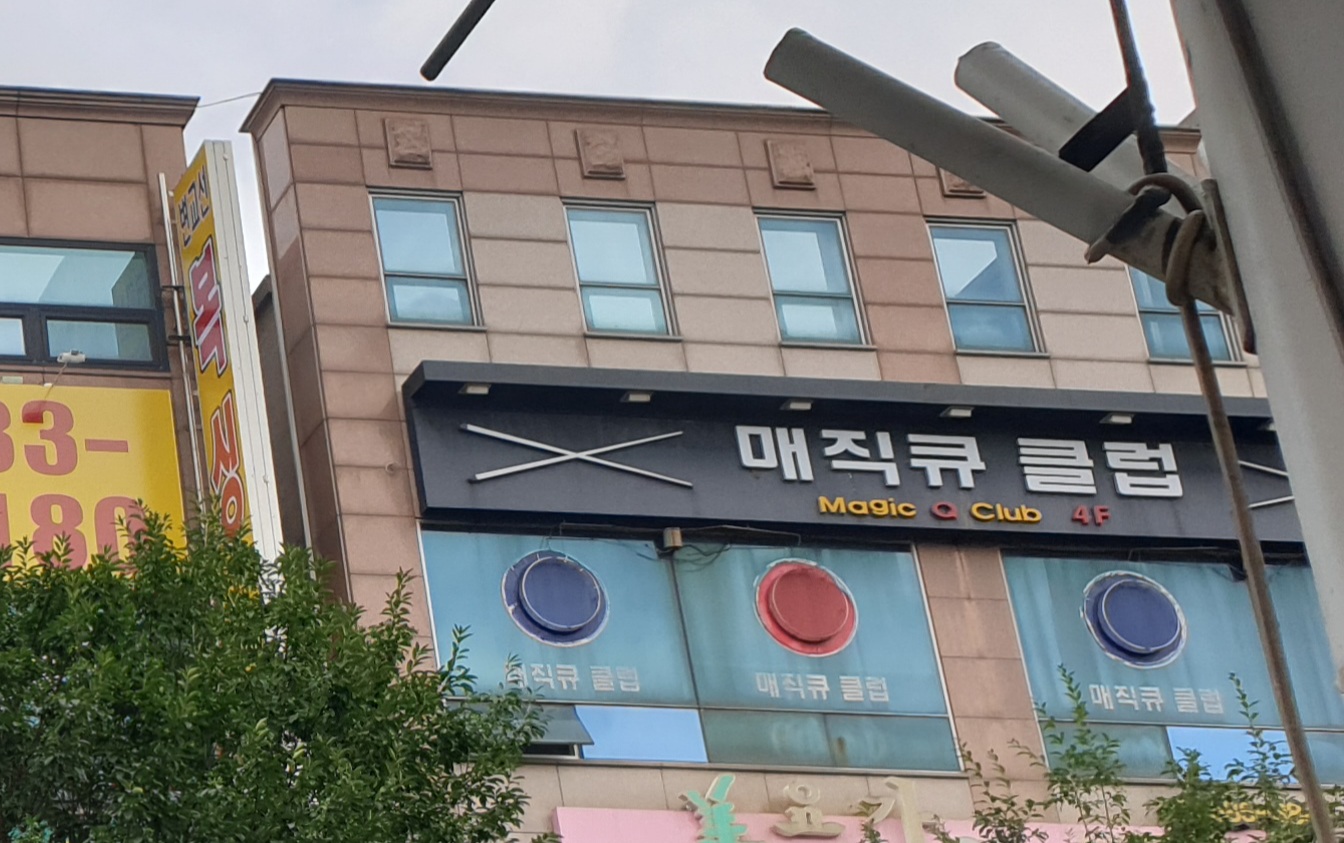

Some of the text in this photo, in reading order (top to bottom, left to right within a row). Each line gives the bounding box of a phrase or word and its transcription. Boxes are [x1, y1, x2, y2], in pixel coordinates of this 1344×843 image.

[178, 165, 210, 247] 변교선
[188, 235, 245, 540] 복싱
[734, 424, 1184, 498] 매직큐 클럽
[817, 495, 1110, 526] Magic Q Club 4F
[589, 665, 641, 693] 클럽
[755, 671, 891, 702] 매직큐 클럽
[1088, 683, 1225, 715] 매직큐 클럽
